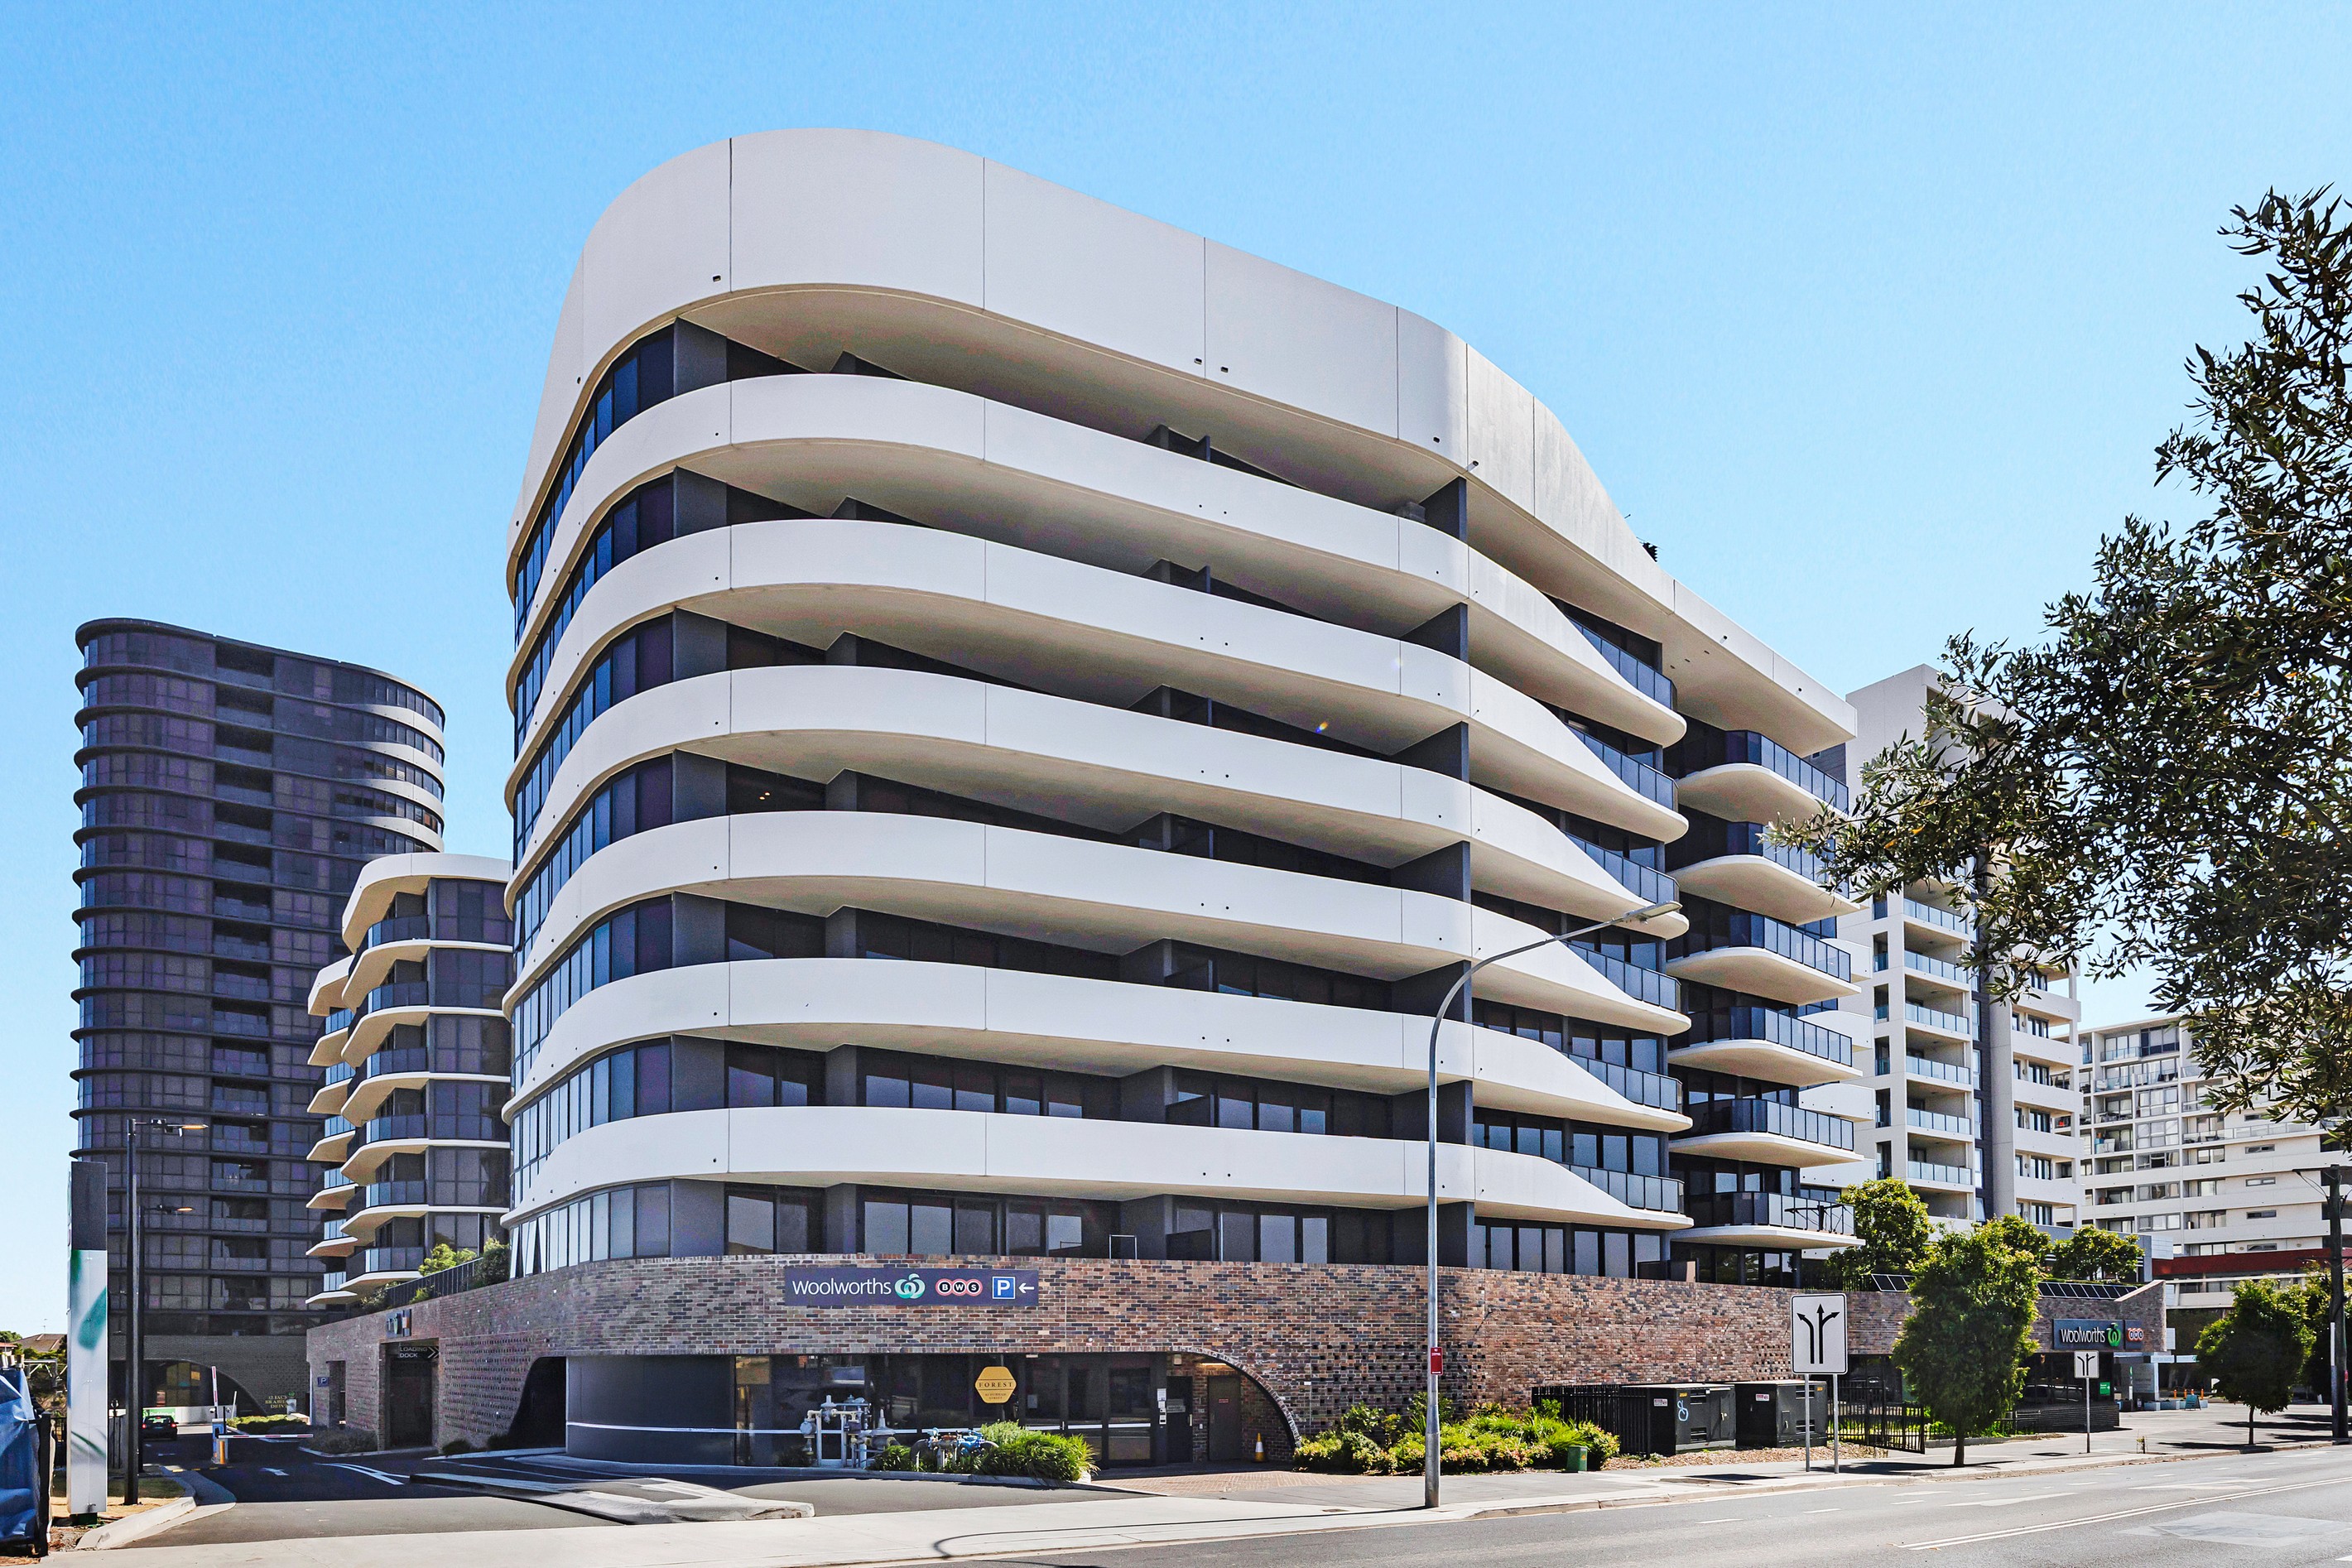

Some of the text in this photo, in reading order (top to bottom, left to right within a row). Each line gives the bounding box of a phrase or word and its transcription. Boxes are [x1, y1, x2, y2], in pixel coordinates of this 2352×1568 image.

[792, 1277, 1011, 1296] Woolworths BWS P
[2061, 1326, 2106, 1343] Woolworths
